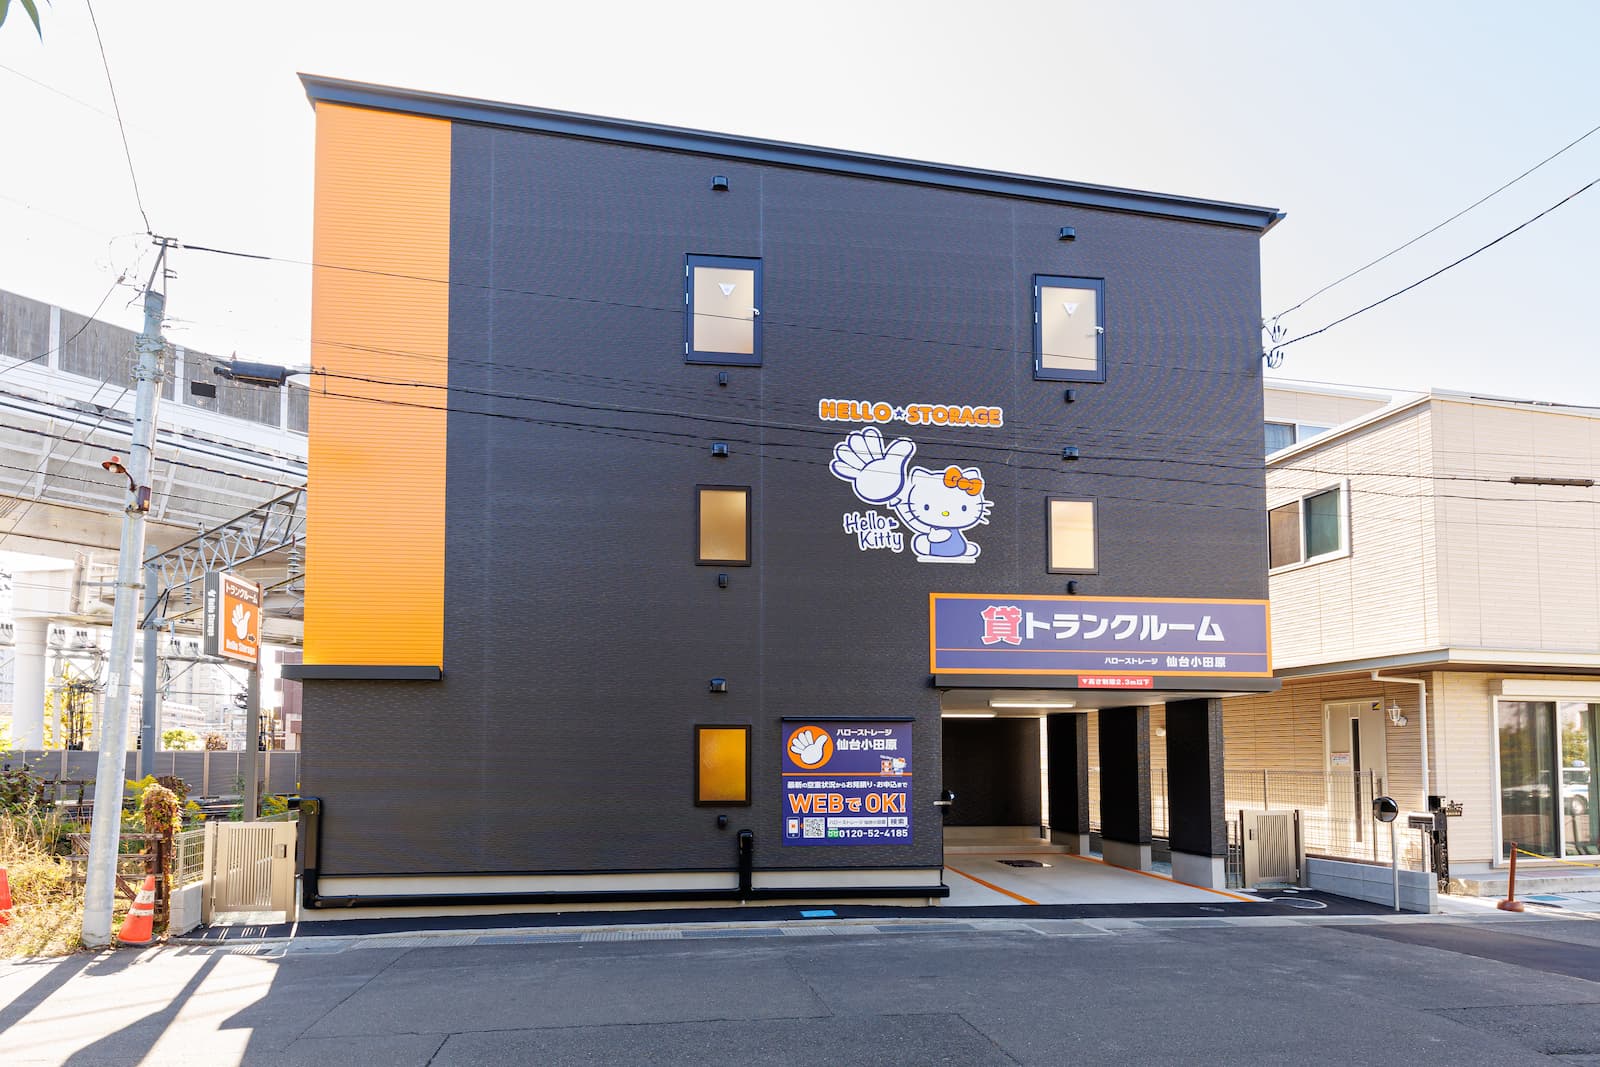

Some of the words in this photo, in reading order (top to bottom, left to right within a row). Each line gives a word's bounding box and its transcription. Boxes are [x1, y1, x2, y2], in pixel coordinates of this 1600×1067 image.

[819, 400, 893, 422] HELLO
[905, 405, 1002, 426] STORAGE
[844, 513, 886, 534] Hello
[859, 532, 903, 551] Kitty
[226, 582, 258, 604] トランクルーム
[1104, 656, 1159, 666] ハローストレージ
[1166, 655, 1227, 669] 仙台小田原
[836, 728, 892, 737] ハローストレージ
[836, 738, 898, 751] 仙台小田原
[788, 793, 907, 814] WEBでOK!
[839, 828, 908, 838] 0120-52-4185
